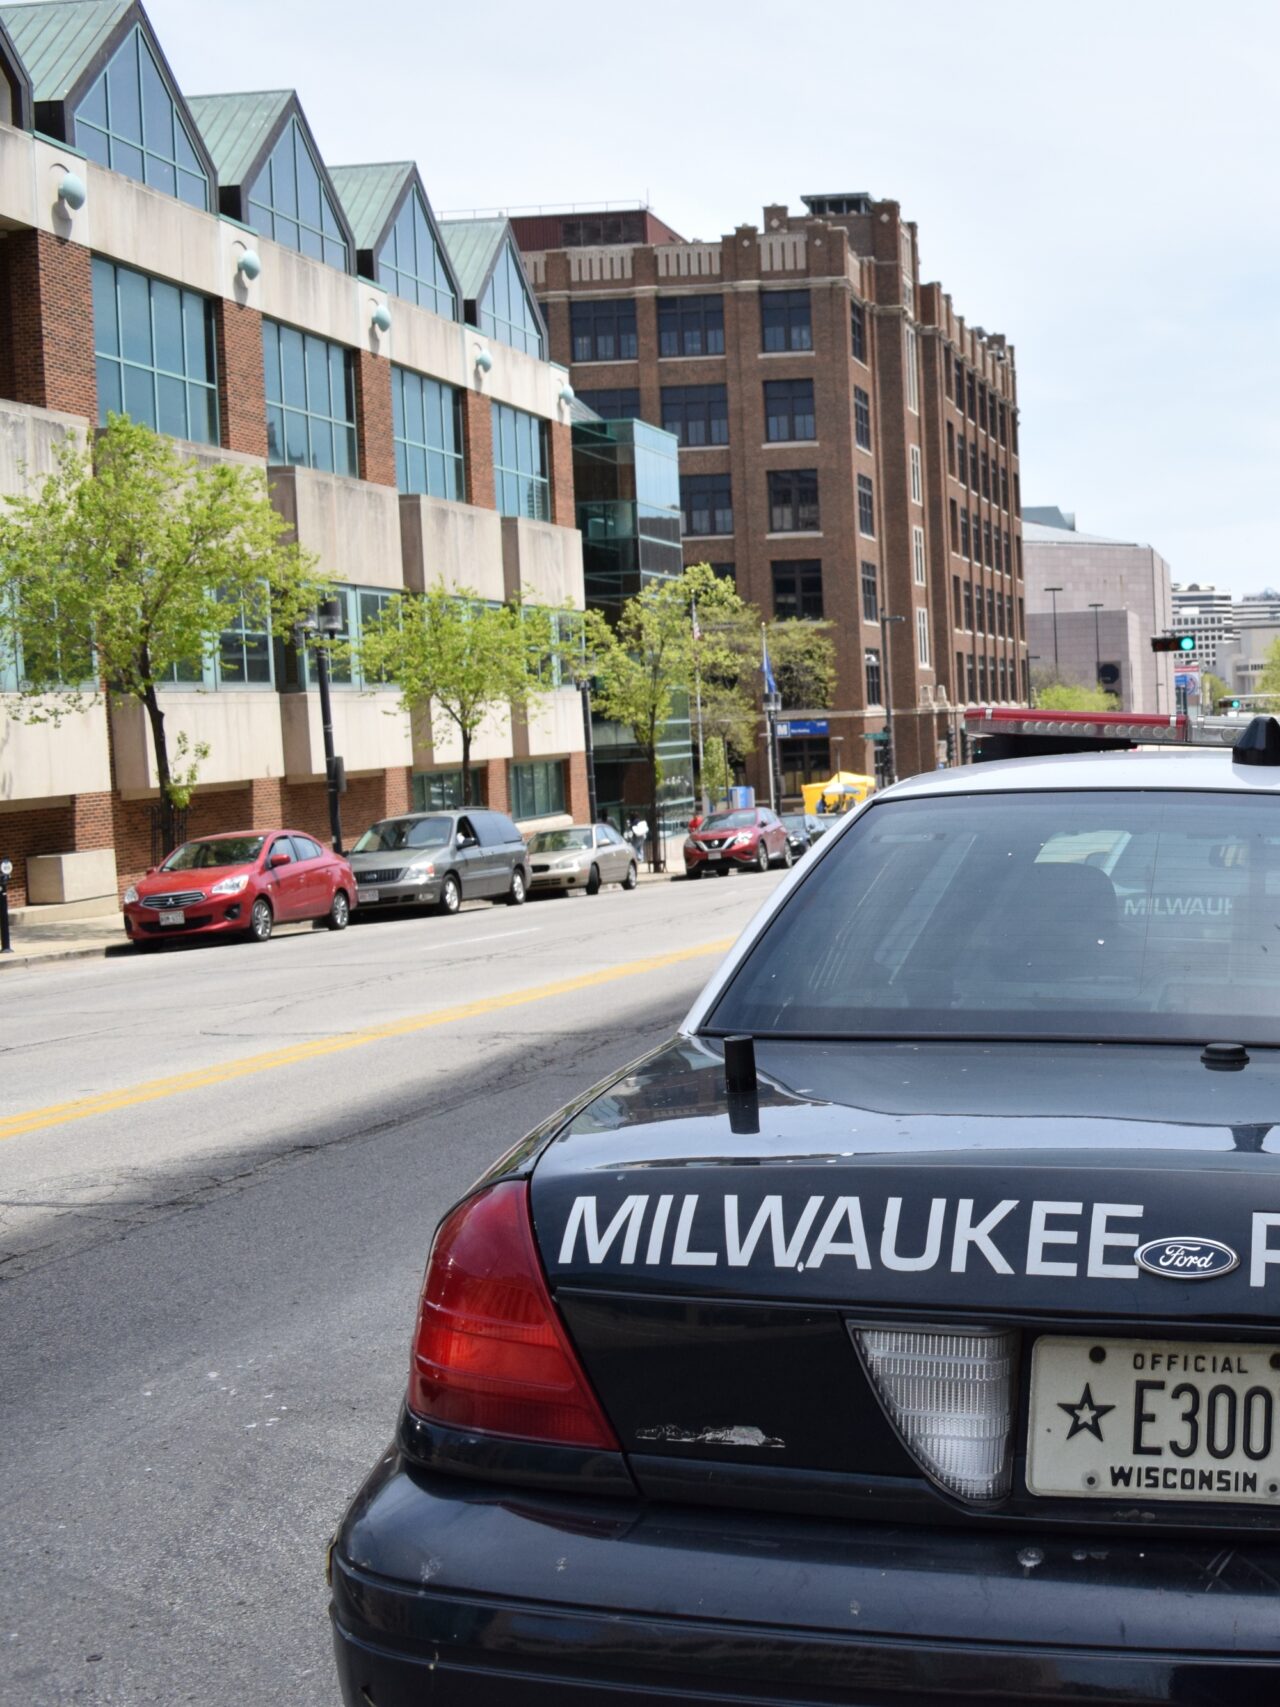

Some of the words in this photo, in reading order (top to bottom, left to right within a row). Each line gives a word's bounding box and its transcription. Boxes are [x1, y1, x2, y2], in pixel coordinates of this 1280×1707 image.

[558, 1194, 1144, 1279] MILWAUKEE
[1159, 1244, 1214, 1269] Ford
[1132, 1353, 1249, 1374] OFFICIAL
[1109, 1465, 1257, 1492] WISCONSIN
